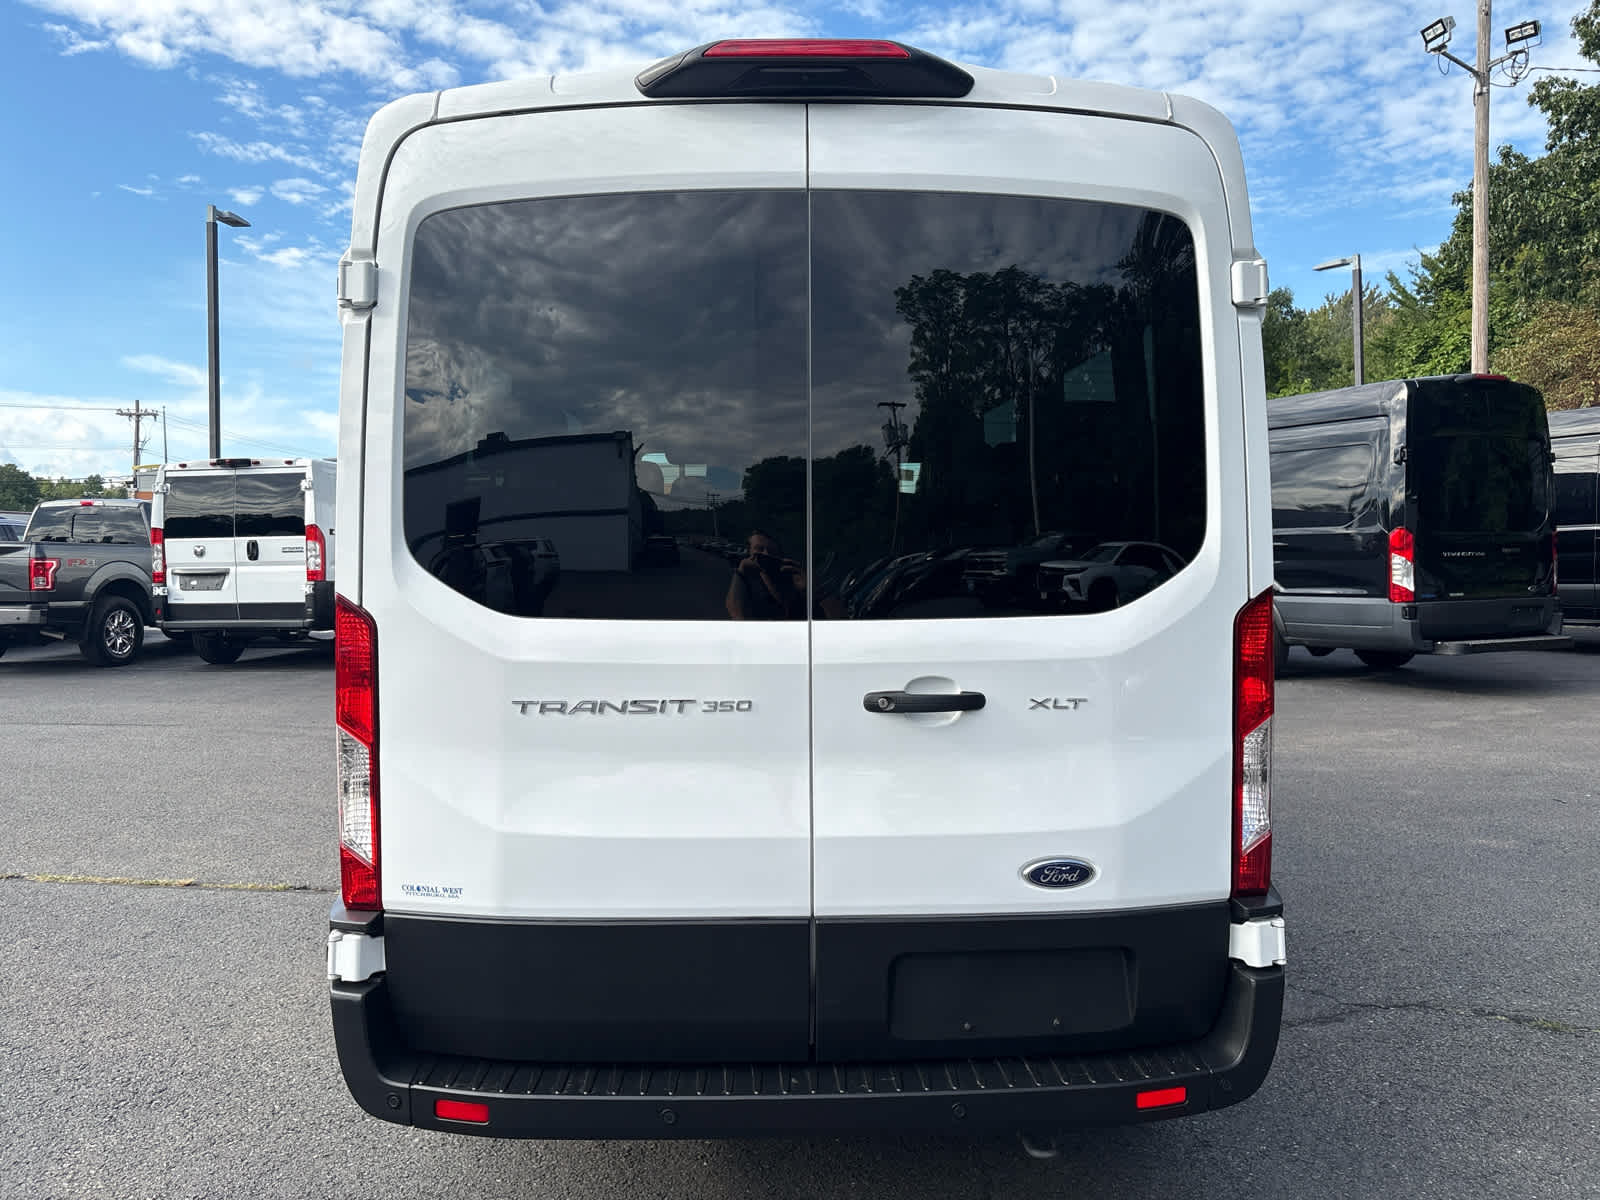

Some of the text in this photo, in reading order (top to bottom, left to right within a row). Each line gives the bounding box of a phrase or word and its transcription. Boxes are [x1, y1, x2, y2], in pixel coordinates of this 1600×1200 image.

[511, 699, 753, 715] TRANSIT 350
[1028, 698, 1088, 710] XLT
[1040, 865, 1080, 882] Ford
[442, 887, 463, 895] WEST
